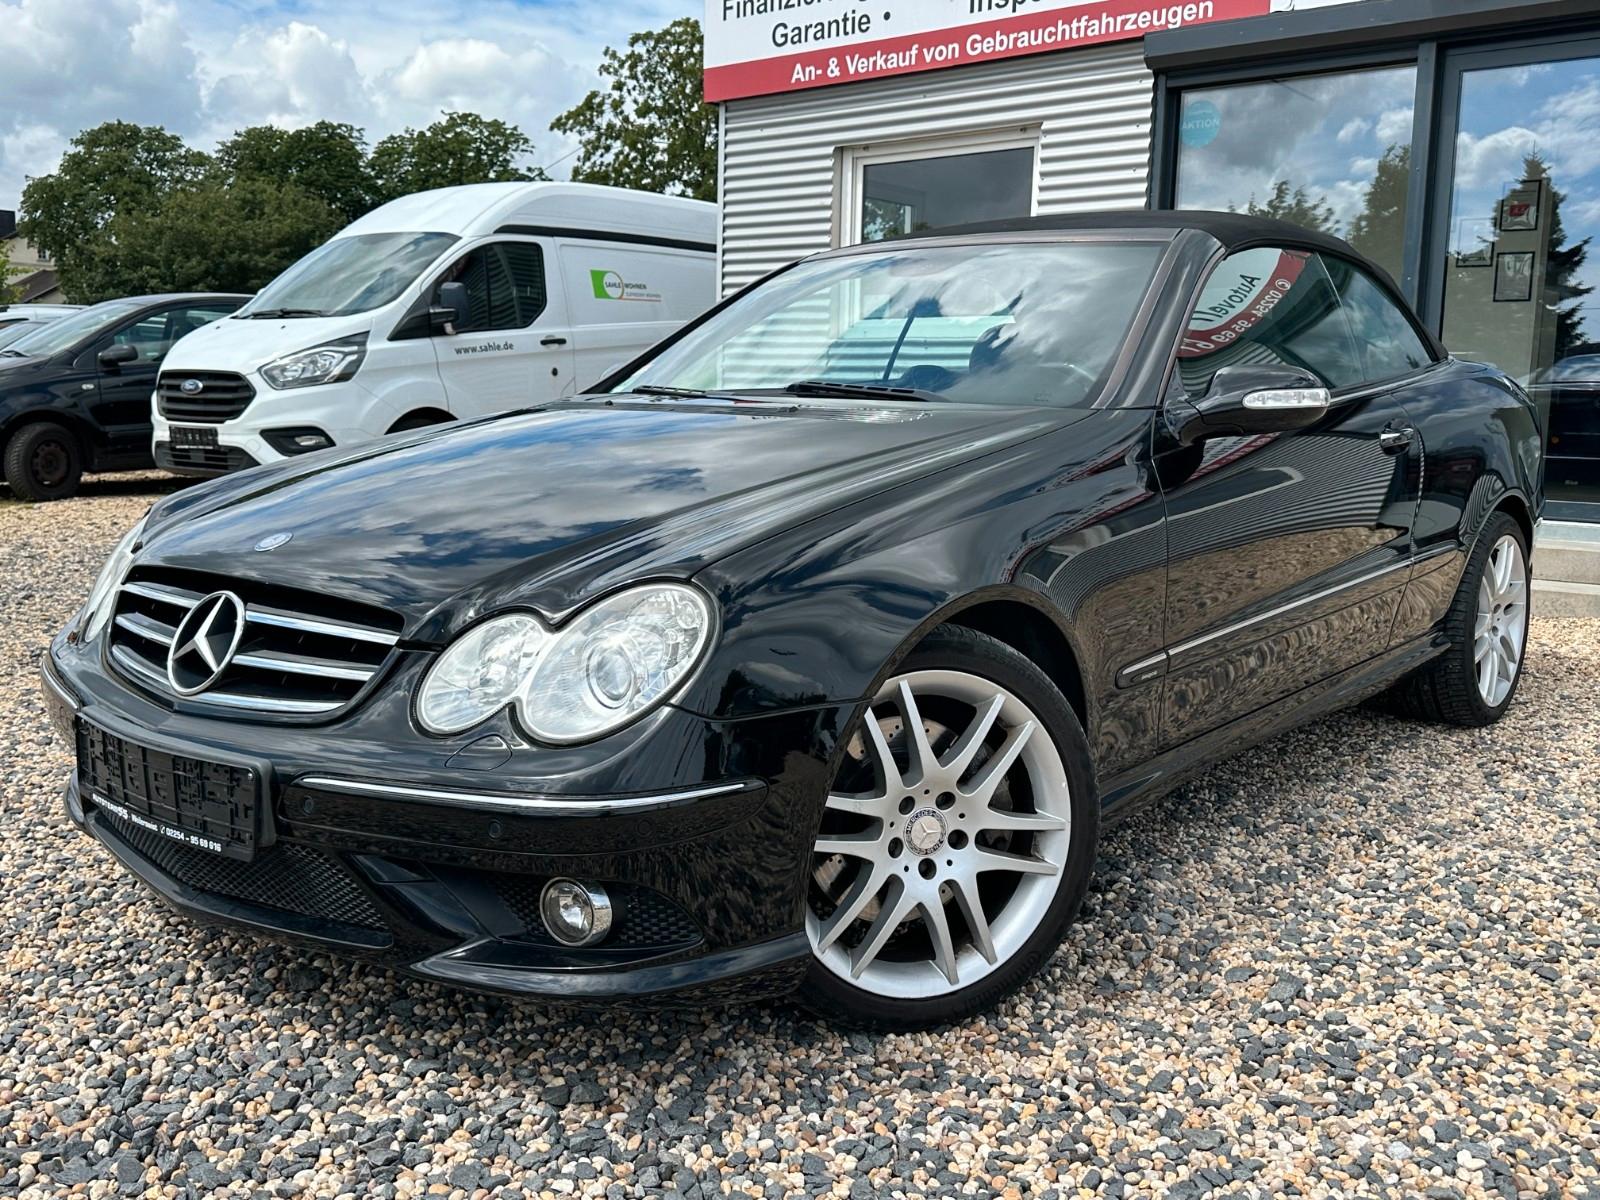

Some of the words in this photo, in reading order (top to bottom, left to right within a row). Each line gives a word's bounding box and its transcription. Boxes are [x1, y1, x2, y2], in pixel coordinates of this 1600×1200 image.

[771, 9, 871, 48] Garantie
[791, 63, 822, 84] An-
[827, 57, 840, 78] &
[845, 44, 919, 75] Verkauf
[923, 42, 960, 64] von
[965, 0, 1214, 57] Gebrauchtfahrzeugen
[454, 341, 514, 355] www.sahle.de
[165, 827, 185, 841] 02254
